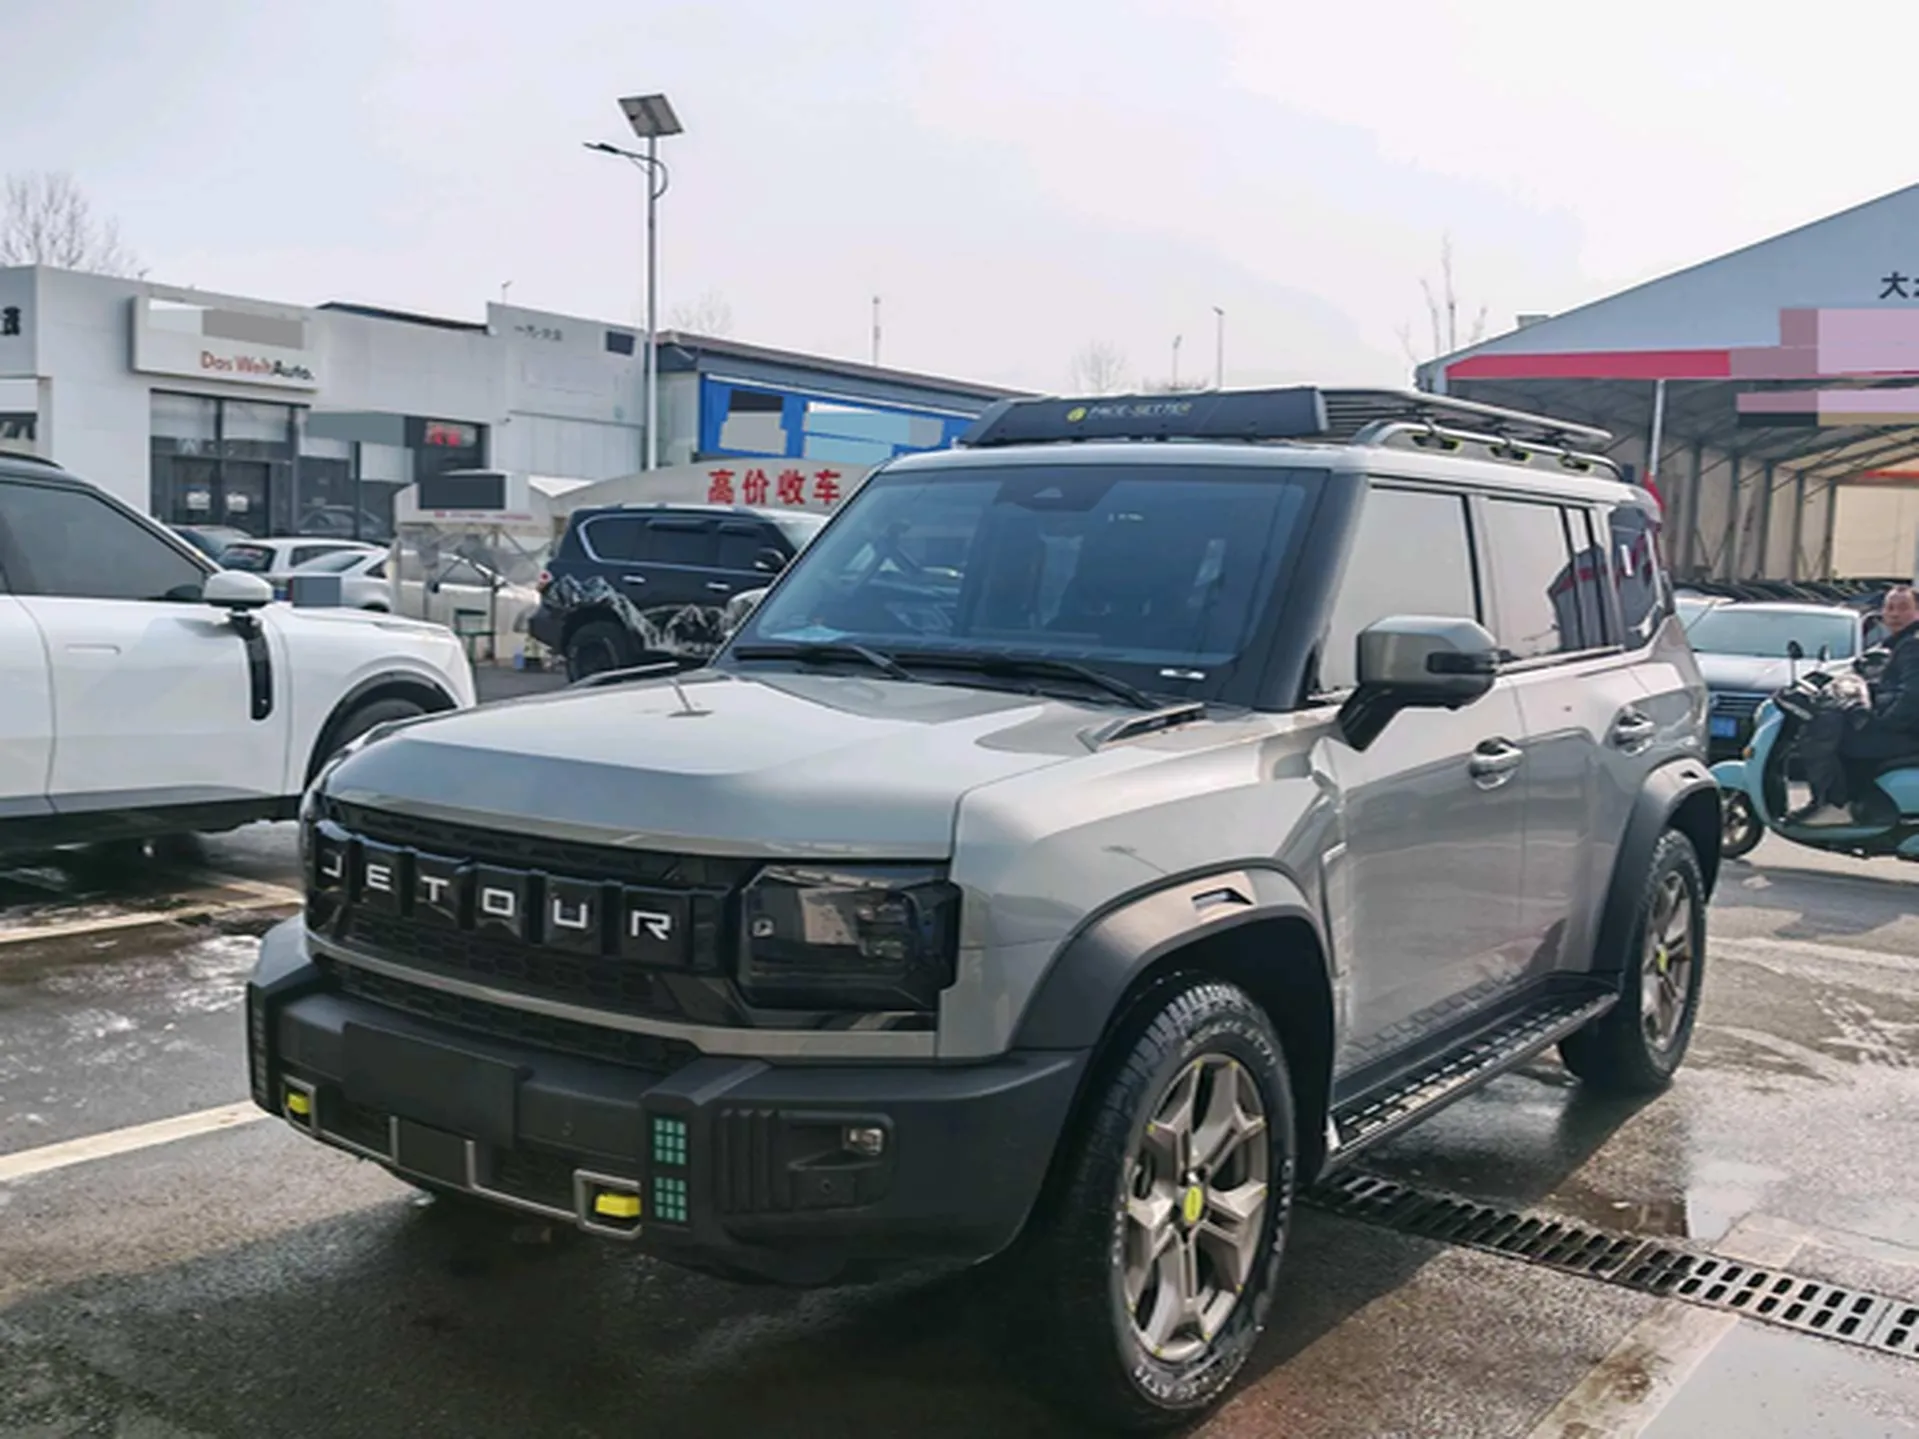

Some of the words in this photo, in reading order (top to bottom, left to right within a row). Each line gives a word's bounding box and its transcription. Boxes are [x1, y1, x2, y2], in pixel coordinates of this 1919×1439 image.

[1879, 271, 1919, 299] 大
[201, 350, 233, 371] Das
[708, 468, 841, 505] 高价收车
[322, 855, 672, 941] JETOUR
